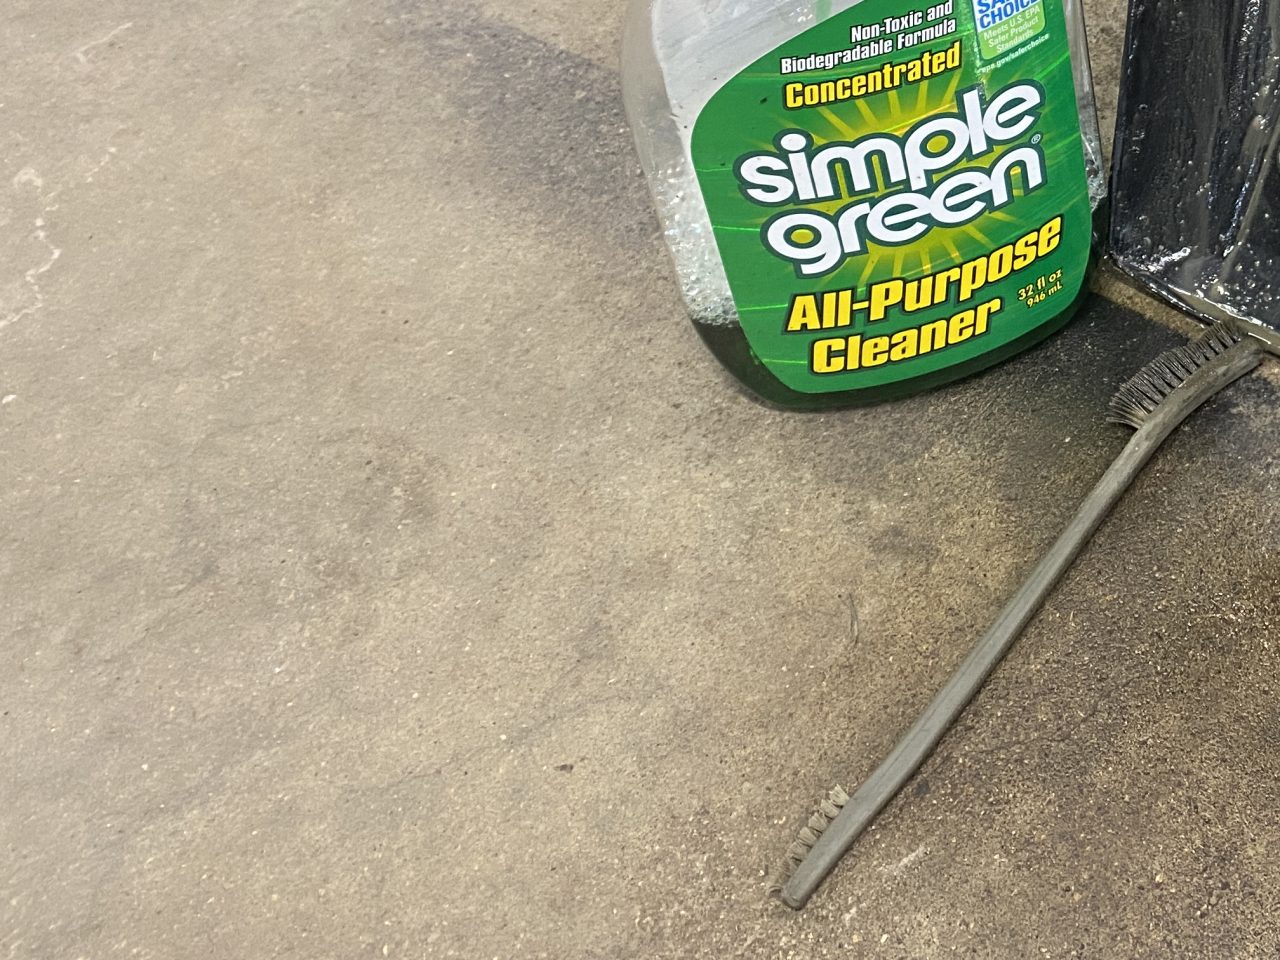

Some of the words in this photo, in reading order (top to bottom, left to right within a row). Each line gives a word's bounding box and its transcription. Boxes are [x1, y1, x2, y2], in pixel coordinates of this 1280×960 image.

[781, 38, 892, 73] Biodegradable
[897, 19, 956, 49] Formula
[851, 10, 922, 42] Non-Toxic
[984, 24, 1008, 40] Meets
[1025, 5, 1040, 19] EPA
[988, 32, 1009, 47] Safer
[1011, 16, 1039, 36] Product
[786, 41, 960, 108] Concentrated
[740, 84, 1040, 203] simple
[767, 147, 1042, 274] green
[787, 216, 1062, 331] All-Purpose
[1018, 284, 1033, 300] 32
[1037, 276, 1045, 290] fl
[1049, 269, 1062, 282] oz
[1027, 291, 1045, 307] 946
[1048, 281, 1062, 295] mL
[813, 298, 1001, 373] Cleaner
